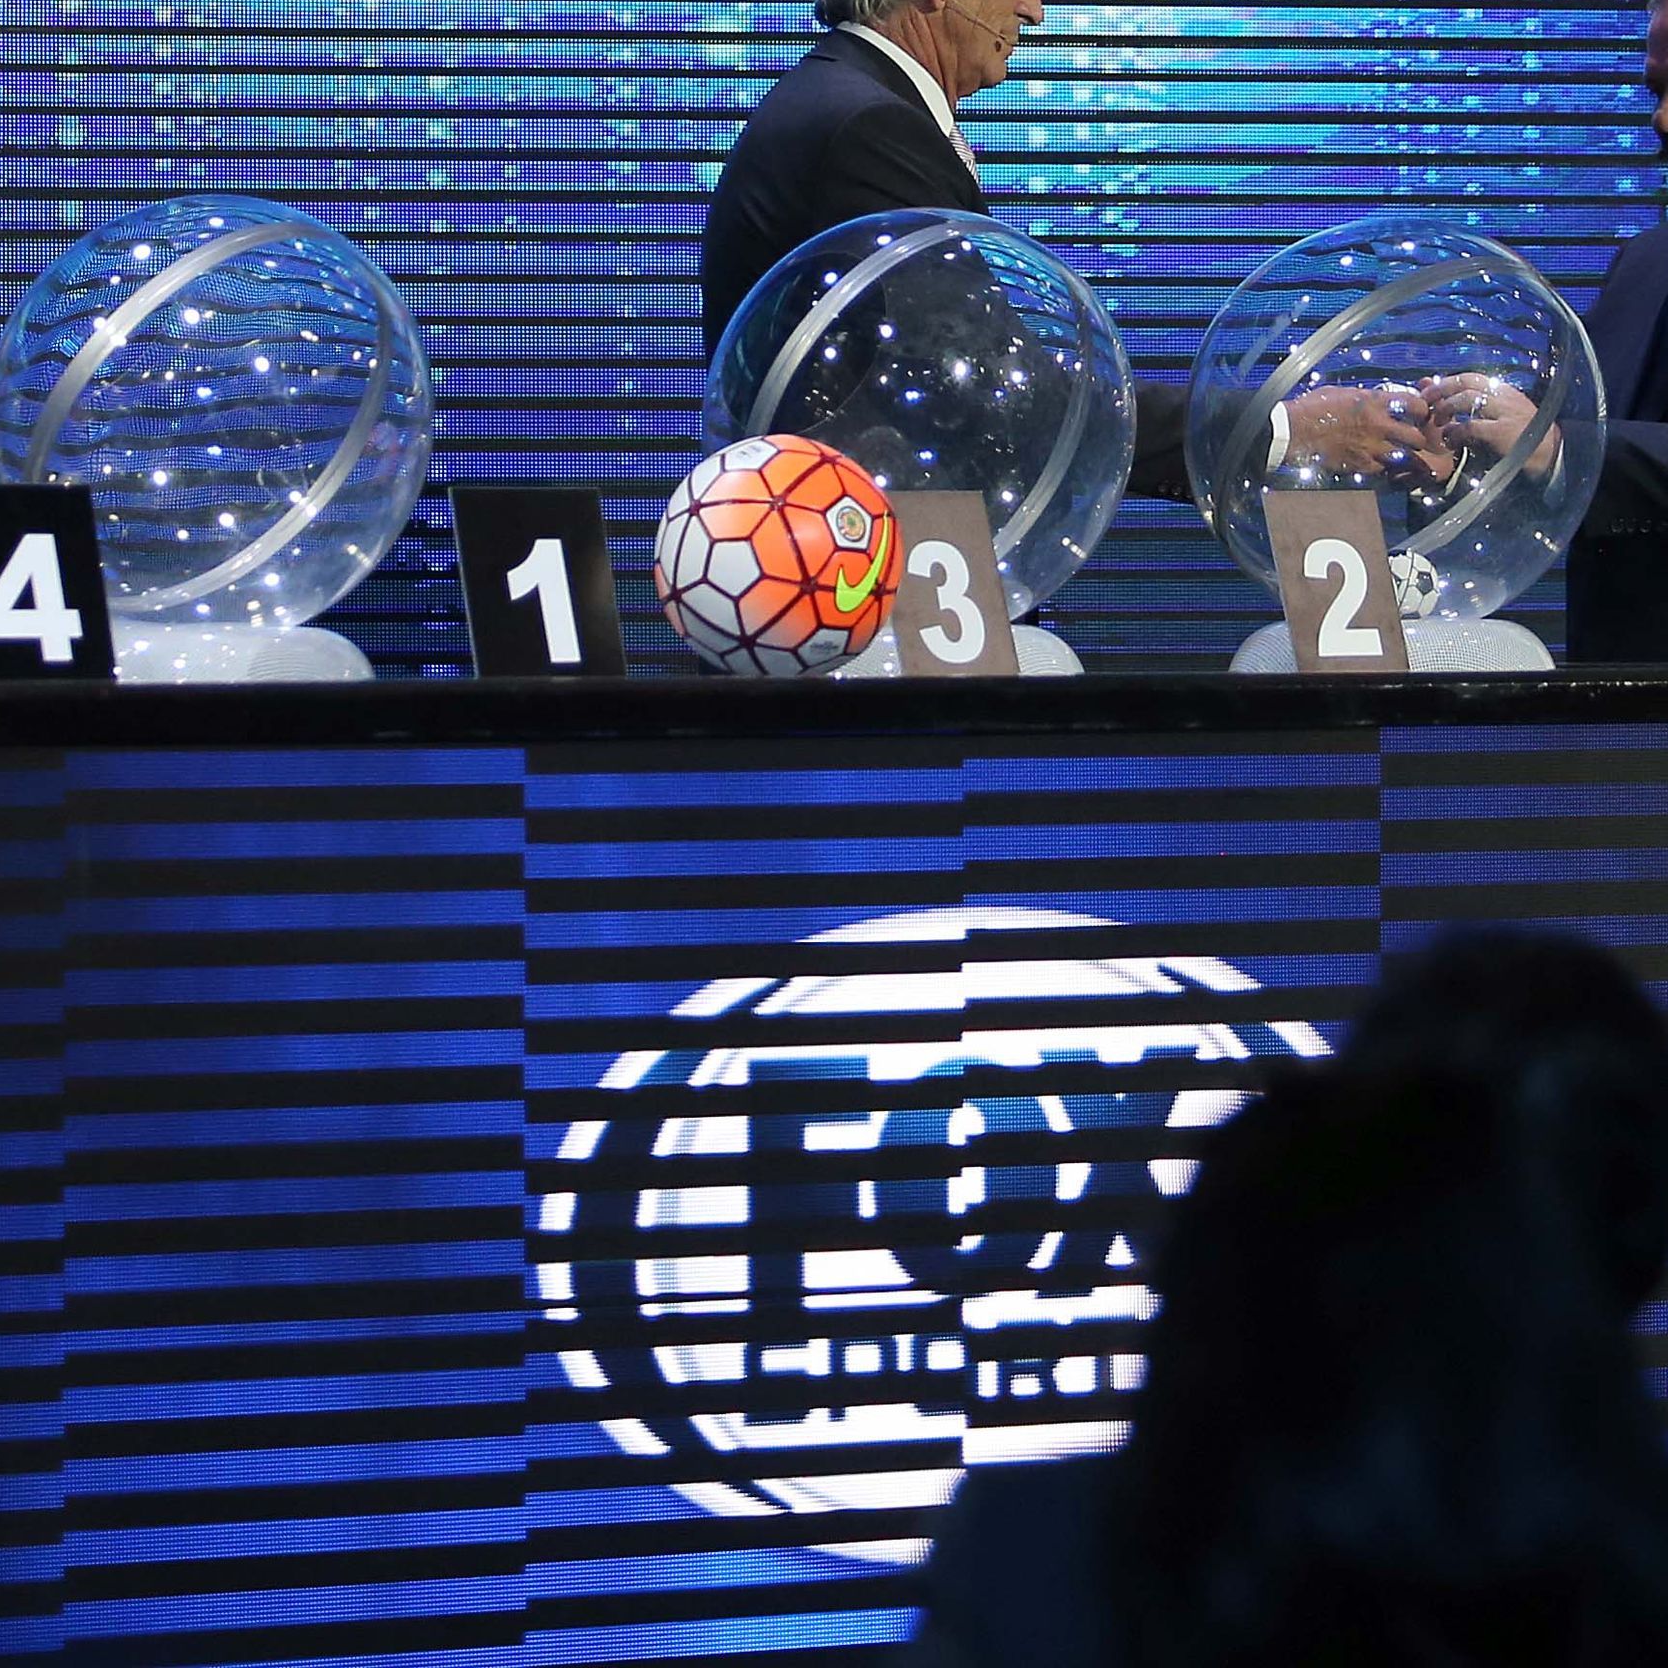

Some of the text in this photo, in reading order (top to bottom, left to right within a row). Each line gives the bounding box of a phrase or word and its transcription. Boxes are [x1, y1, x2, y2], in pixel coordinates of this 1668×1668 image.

[506, 538, 582, 664] 1
[907, 540, 986, 664] 3
[1302, 538, 1384, 658] 2
